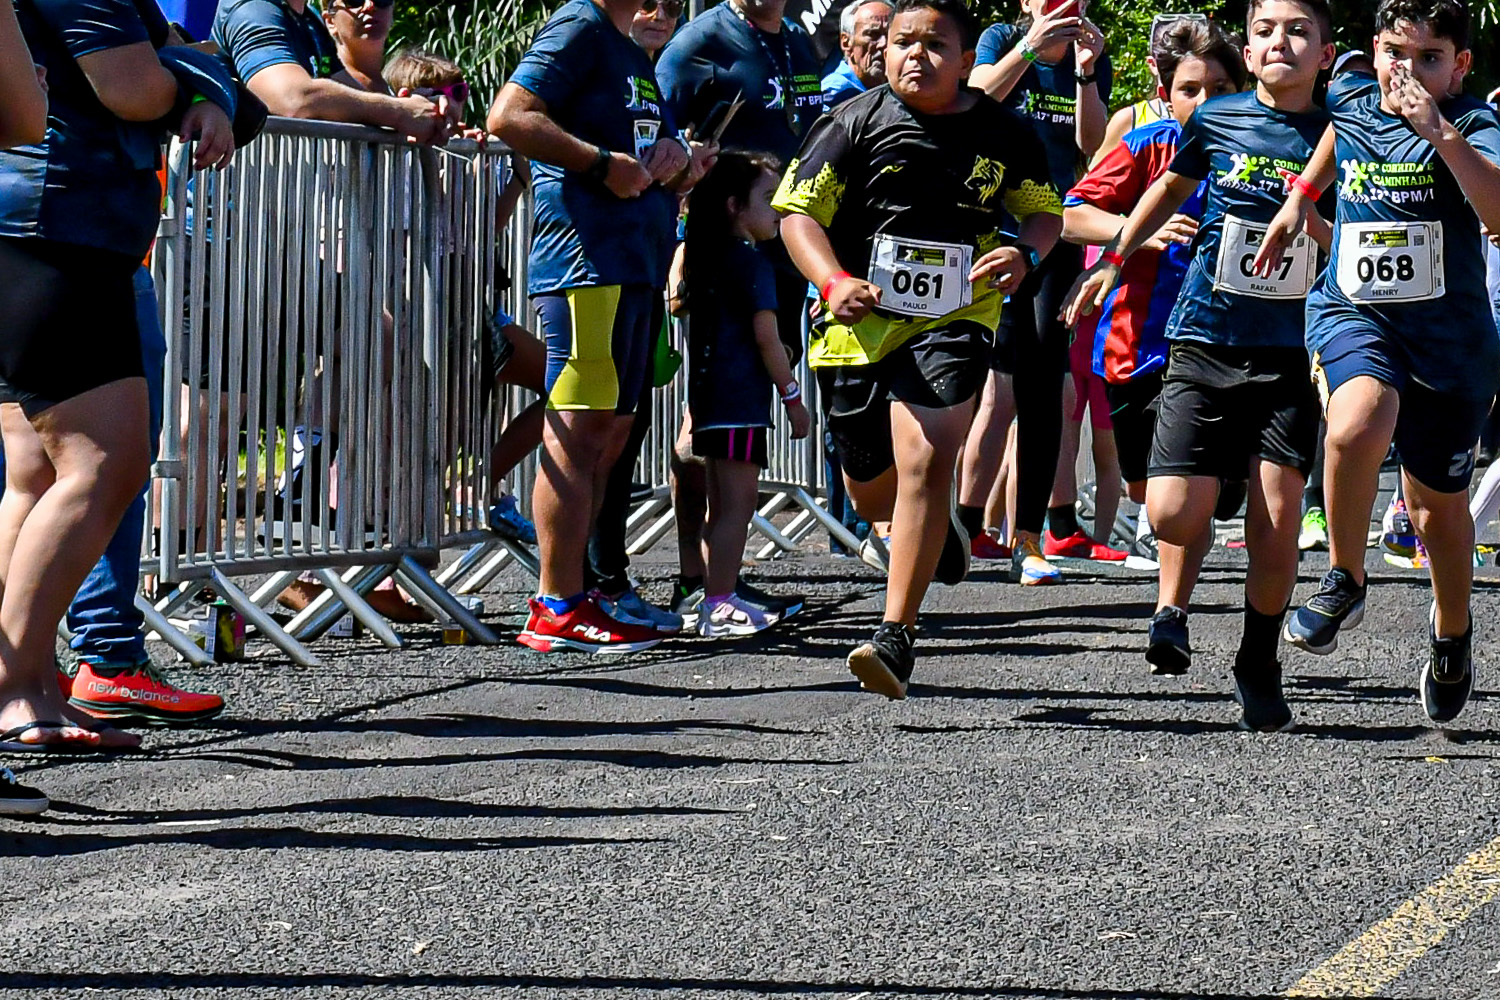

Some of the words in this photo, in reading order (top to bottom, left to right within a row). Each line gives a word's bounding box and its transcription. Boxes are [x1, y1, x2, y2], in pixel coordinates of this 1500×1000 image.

[1273, 158, 1306, 172] CORRI
[1372, 174, 1434, 187] CAMINHADA
[1239, 252, 1294, 281] 07
[1357, 254, 1415, 283] 068
[892, 269, 944, 299] 061
[1250, 283, 1278, 293] RAFAEL
[1372, 288, 1399, 296] HENRY
[902, 301, 927, 310] PAULO
[572, 624, 611, 642] FILA
[88, 681, 117, 695] new
[120, 684, 180, 704] balance
